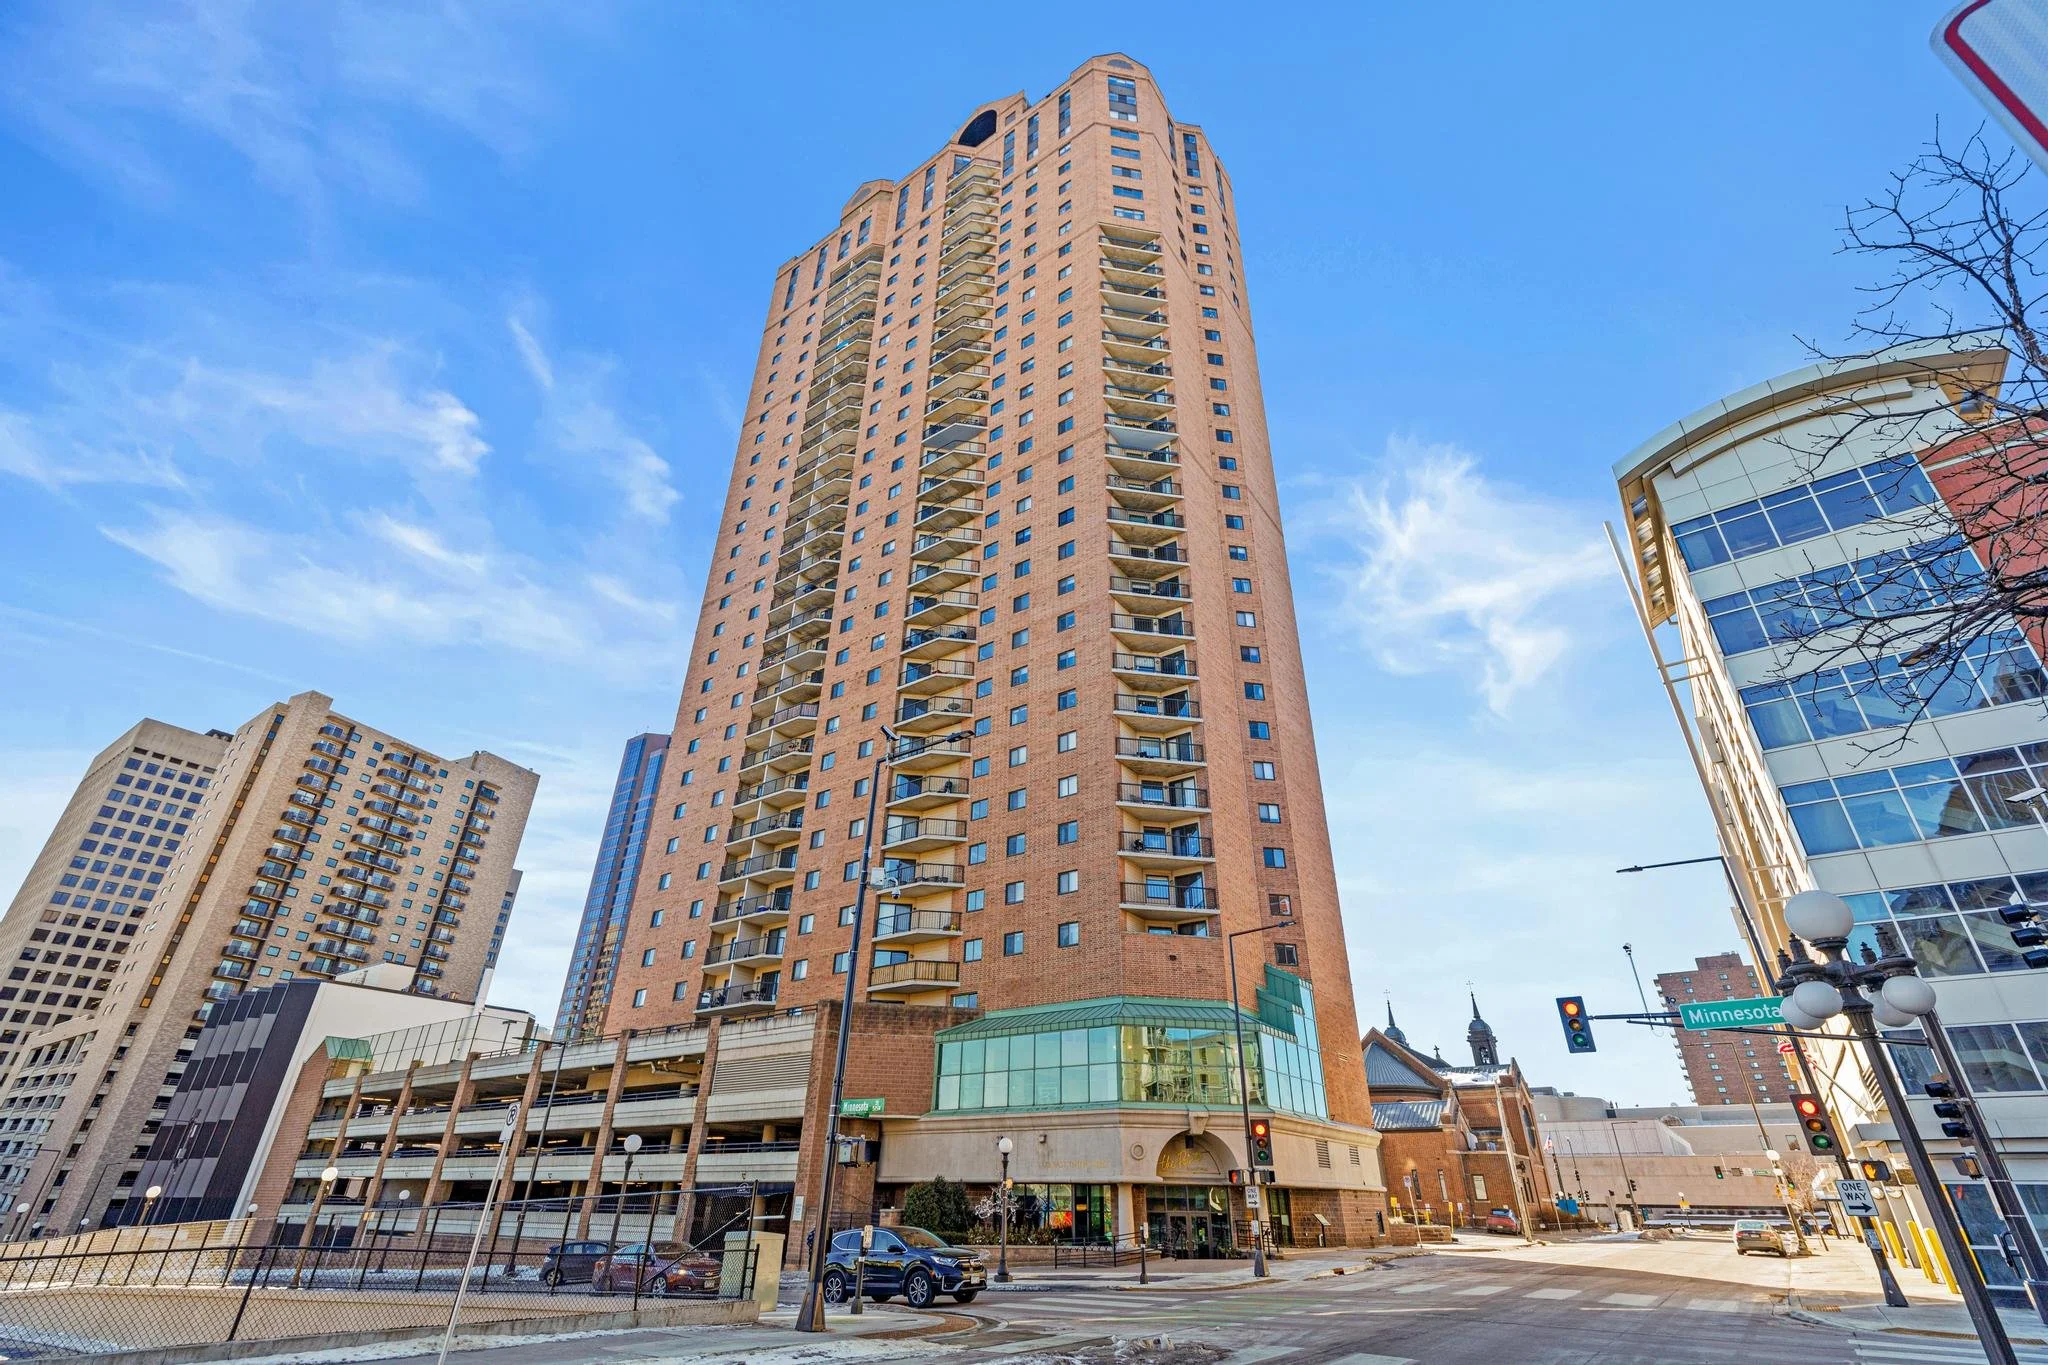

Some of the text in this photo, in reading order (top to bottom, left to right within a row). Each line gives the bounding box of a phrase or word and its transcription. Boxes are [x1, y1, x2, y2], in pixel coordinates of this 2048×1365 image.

[1688, 1004, 1781, 1024] Minnesota
[1841, 1182, 1865, 1192] ONE
[1844, 1192, 1867, 1201] WAY
